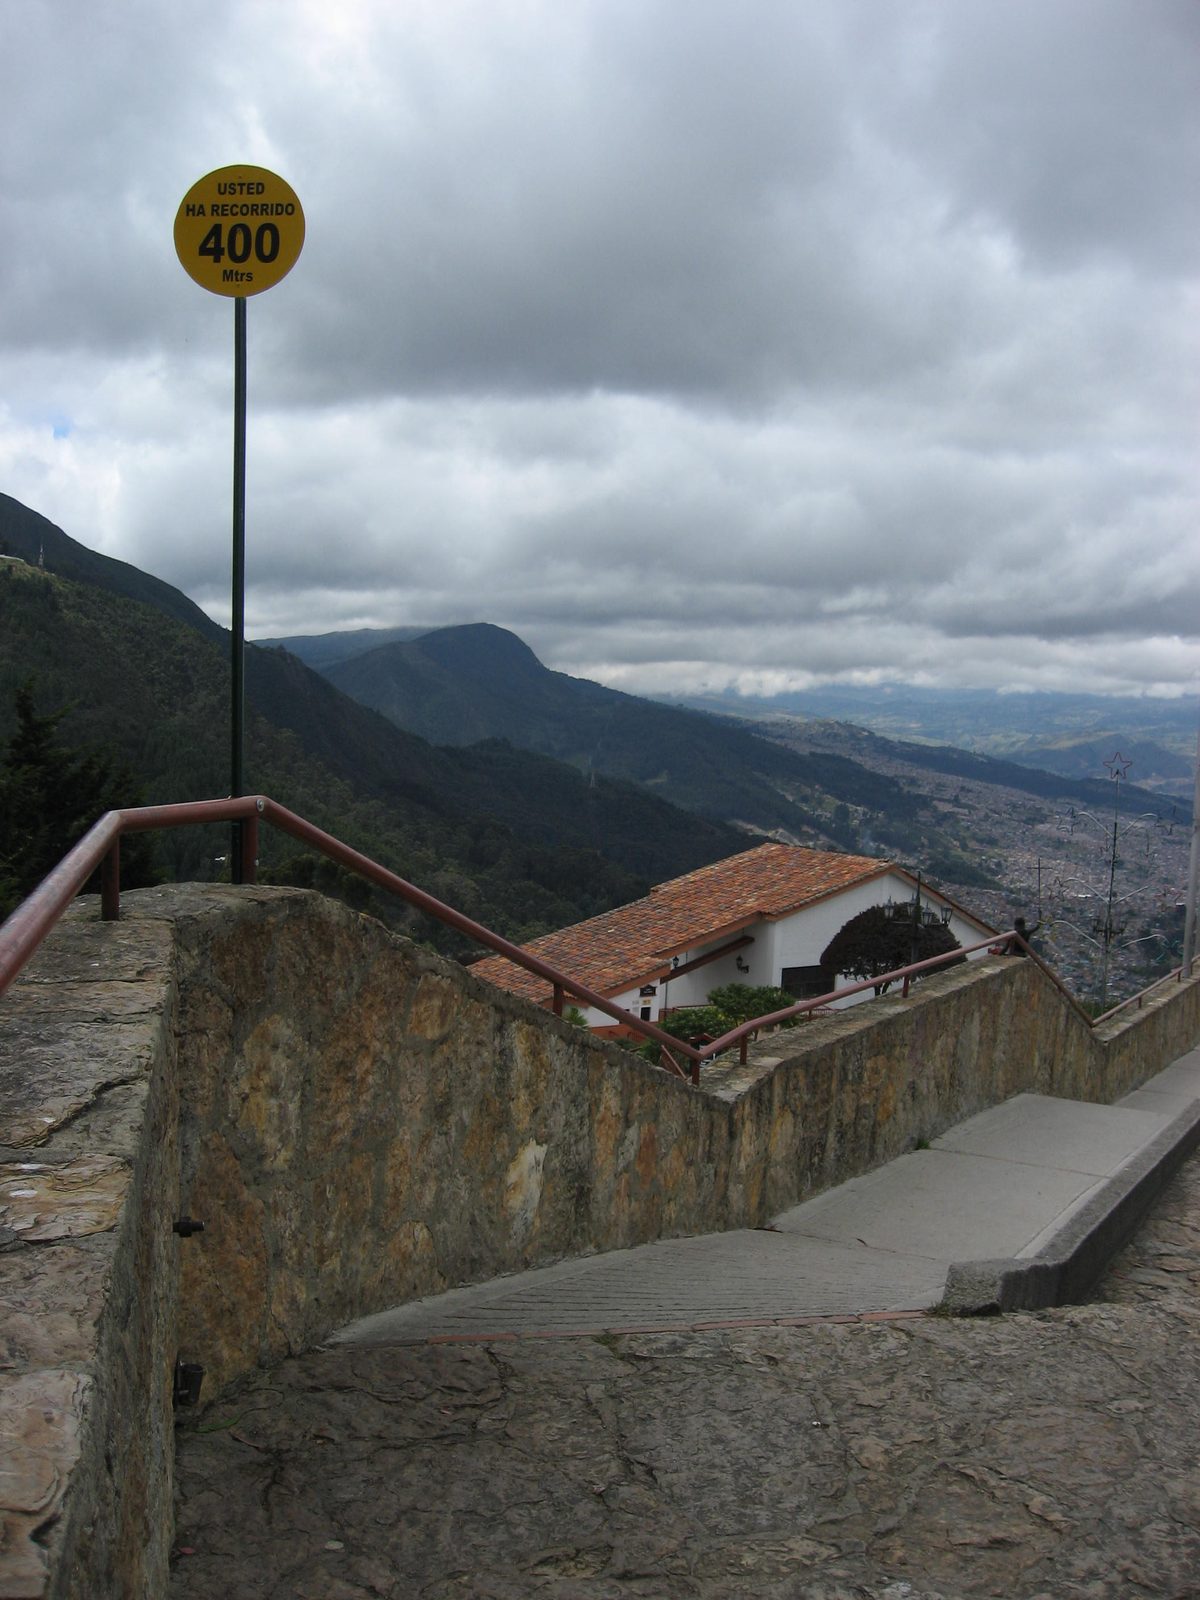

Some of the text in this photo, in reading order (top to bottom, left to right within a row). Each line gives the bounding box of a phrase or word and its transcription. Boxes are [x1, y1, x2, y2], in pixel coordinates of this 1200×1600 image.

[217, 182, 265, 195] USTED
[185, 203, 295, 216] HA RECORRIDO
[198, 222, 280, 263] 400
[222, 269, 253, 282] Mtrs
